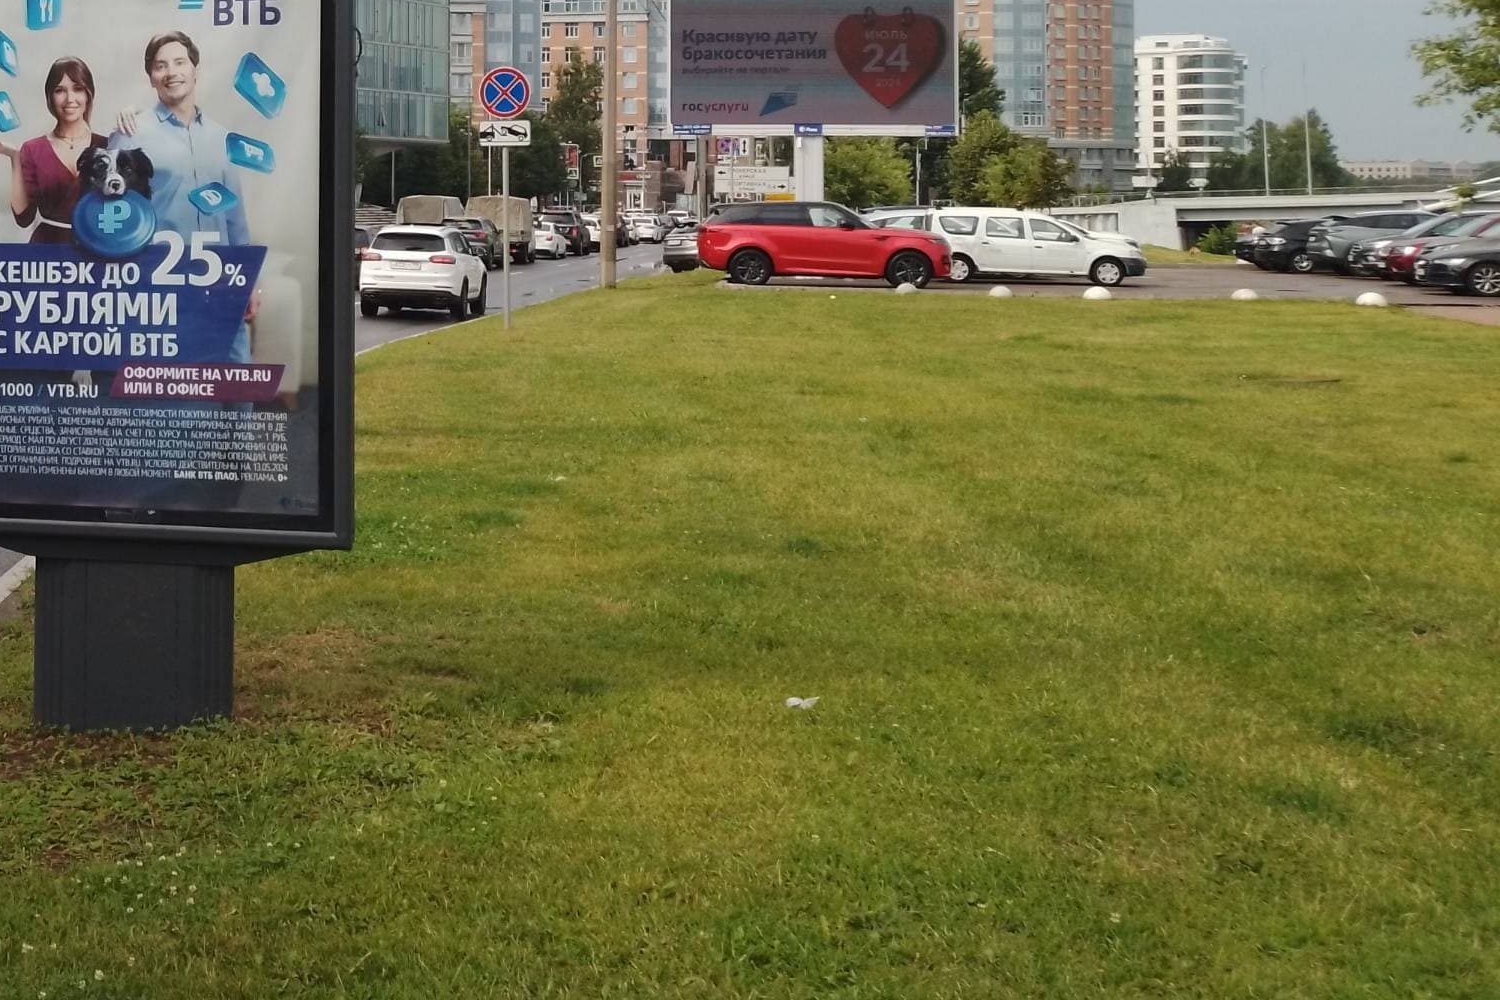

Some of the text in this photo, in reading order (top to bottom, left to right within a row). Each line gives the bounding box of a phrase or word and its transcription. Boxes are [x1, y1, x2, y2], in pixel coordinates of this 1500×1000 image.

[682, 28, 818, 45] Красивую дату
[682, 46, 827, 63] бракосочетания
[862, 43, 911, 73] 24
[682, 101, 749, 114] госуслуги
[101, 262, 140, 288] ДО
[14, 327, 122, 357] КАРТОЙ
[130, 332, 179, 358] ВТБ
[123, 366, 271, 382] ОФОРМИТЕ НА VTB.RU
[47, 383, 99, 399] VTB.RU
[123, 381, 215, 397] ИЛИ В ОФИСЕ
